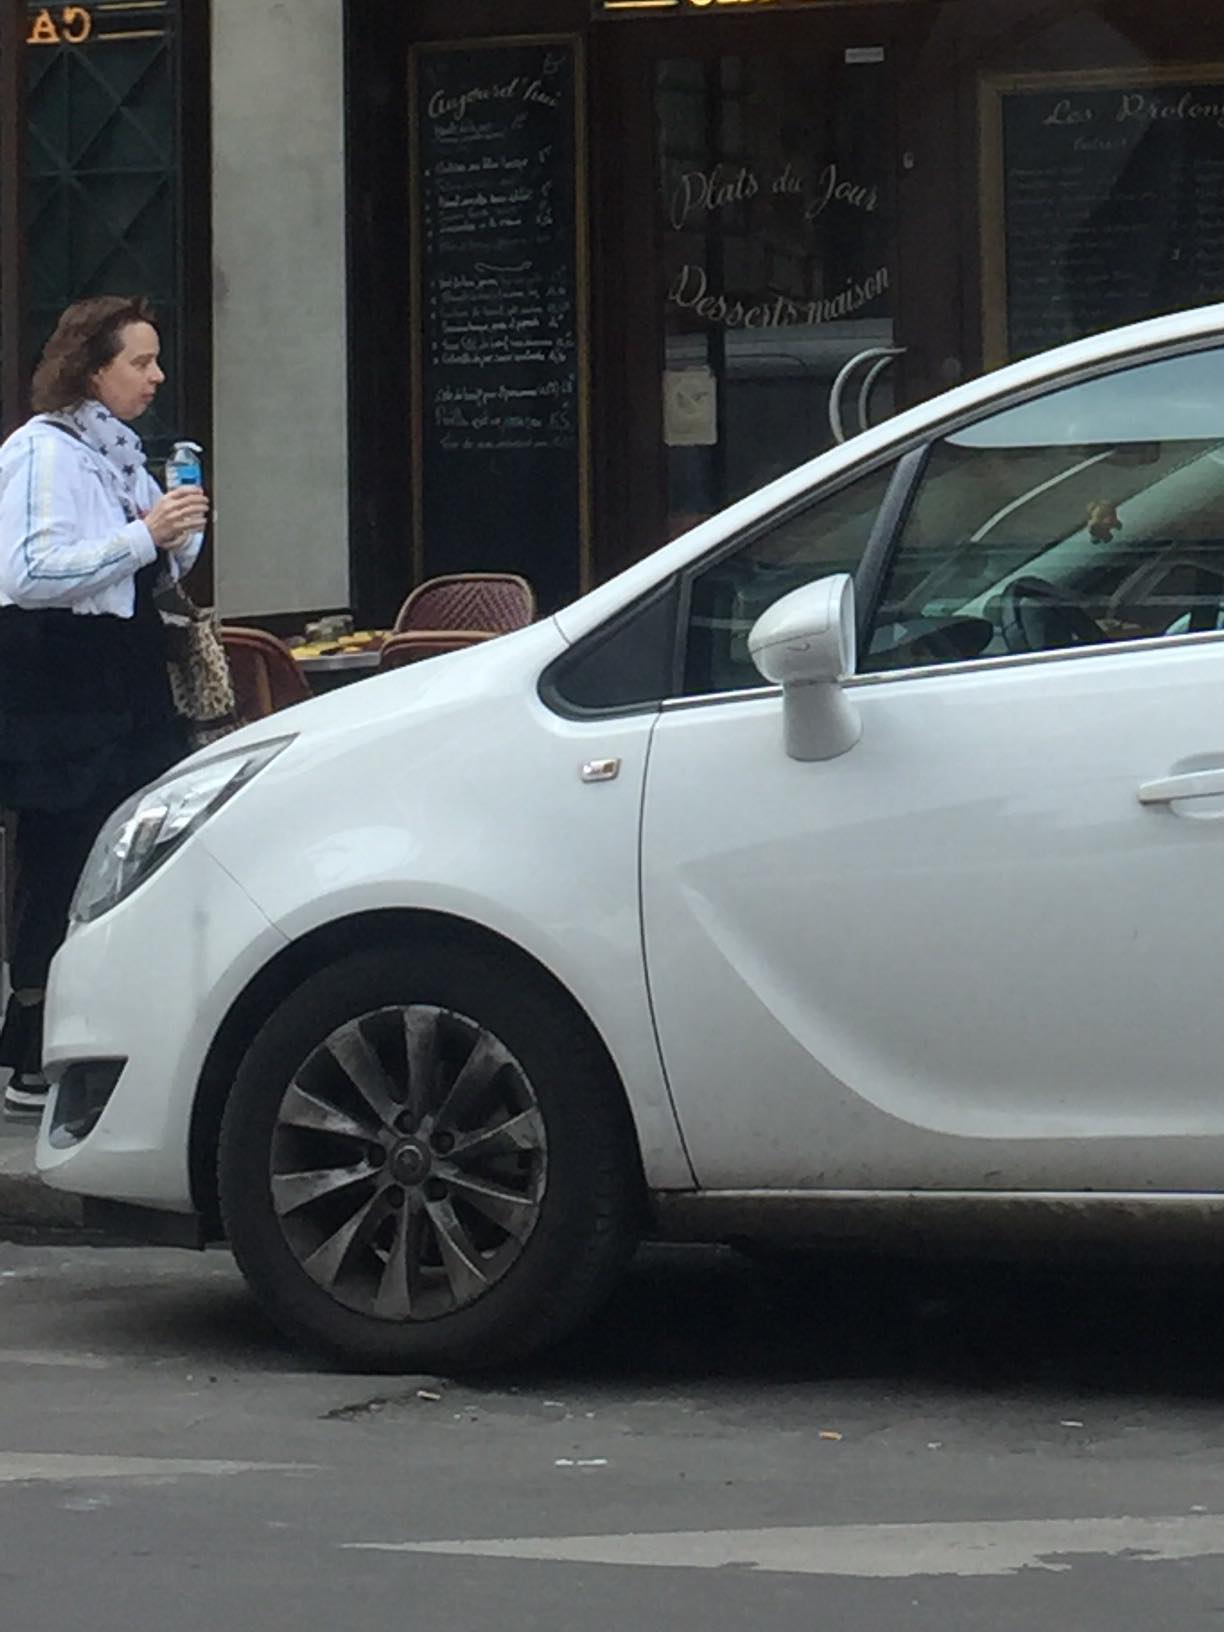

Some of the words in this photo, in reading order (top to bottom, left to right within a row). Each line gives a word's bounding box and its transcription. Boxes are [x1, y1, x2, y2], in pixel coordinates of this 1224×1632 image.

[671, 163, 758, 230] Plats
[771, 162, 801, 193] du
[804, 164, 879, 219] Jour
[669, 264, 797, 328] Desserts
[808, 266, 888, 324] maison
